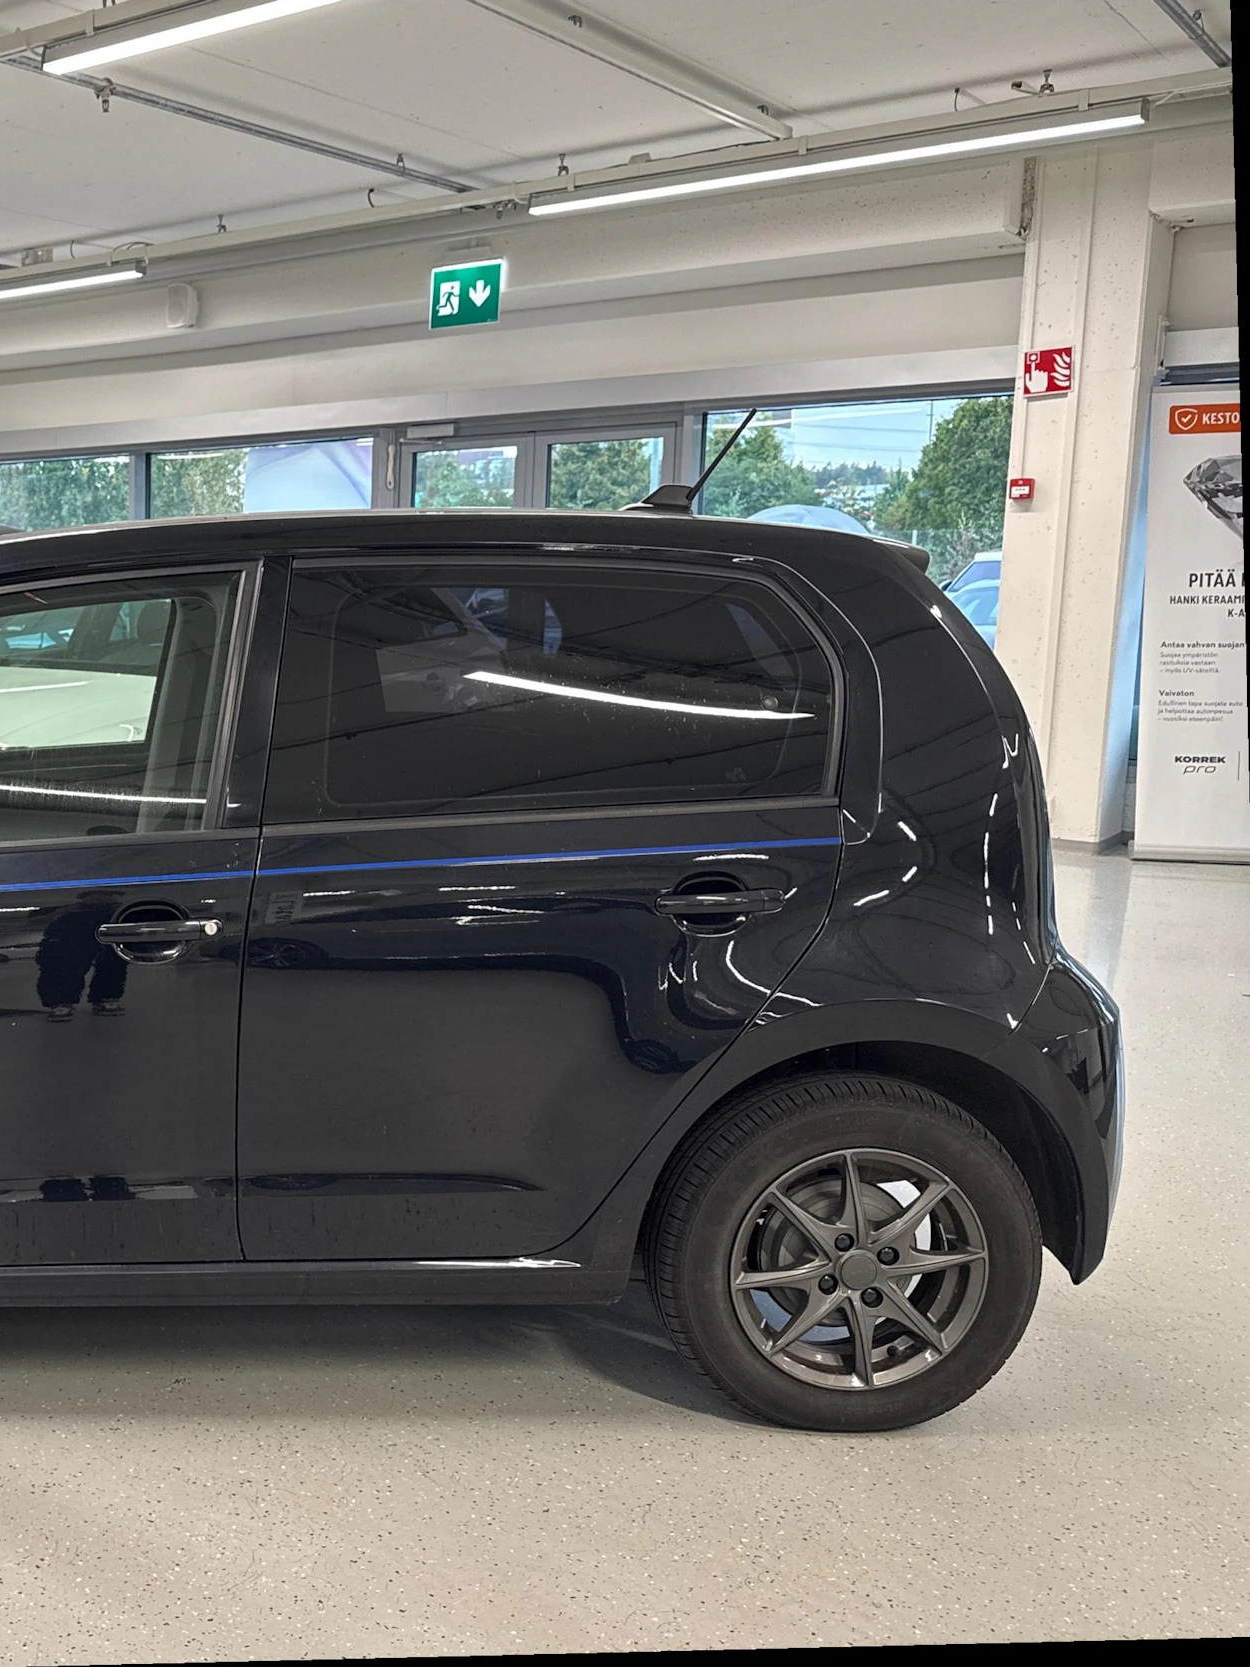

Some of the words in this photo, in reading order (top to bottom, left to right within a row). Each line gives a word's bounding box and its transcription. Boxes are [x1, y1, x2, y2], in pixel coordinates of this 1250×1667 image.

[1189, 568, 1236, 588] PITÄÄ
[1169, 595, 1200, 605] HANKI
[1218, 641, 1245, 650] suojan
[1158, 689, 1195, 697] Vaivaton
[1174, 755, 1226, 764] KORREK
[1183, 765, 1217, 775] pro
